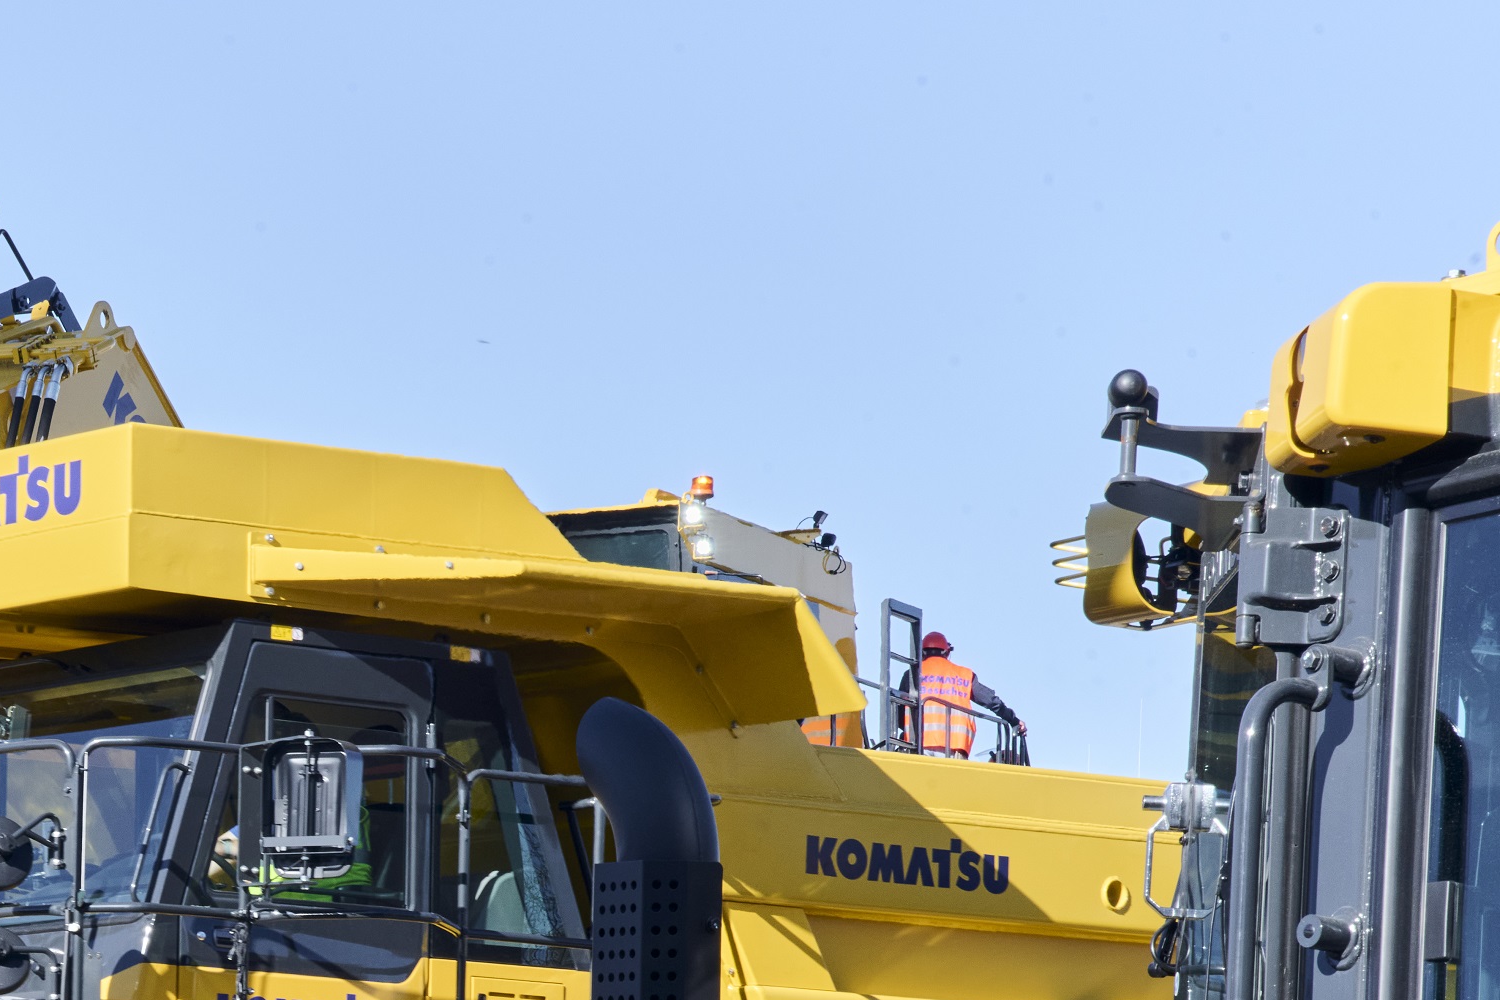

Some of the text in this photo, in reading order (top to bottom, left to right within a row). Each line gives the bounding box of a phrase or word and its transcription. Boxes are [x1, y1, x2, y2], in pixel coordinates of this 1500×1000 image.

[920, 674, 970, 687] KOMATSU
[920, 686, 968, 698] Besucher
[805, 834, 1010, 895] KOMATSU
